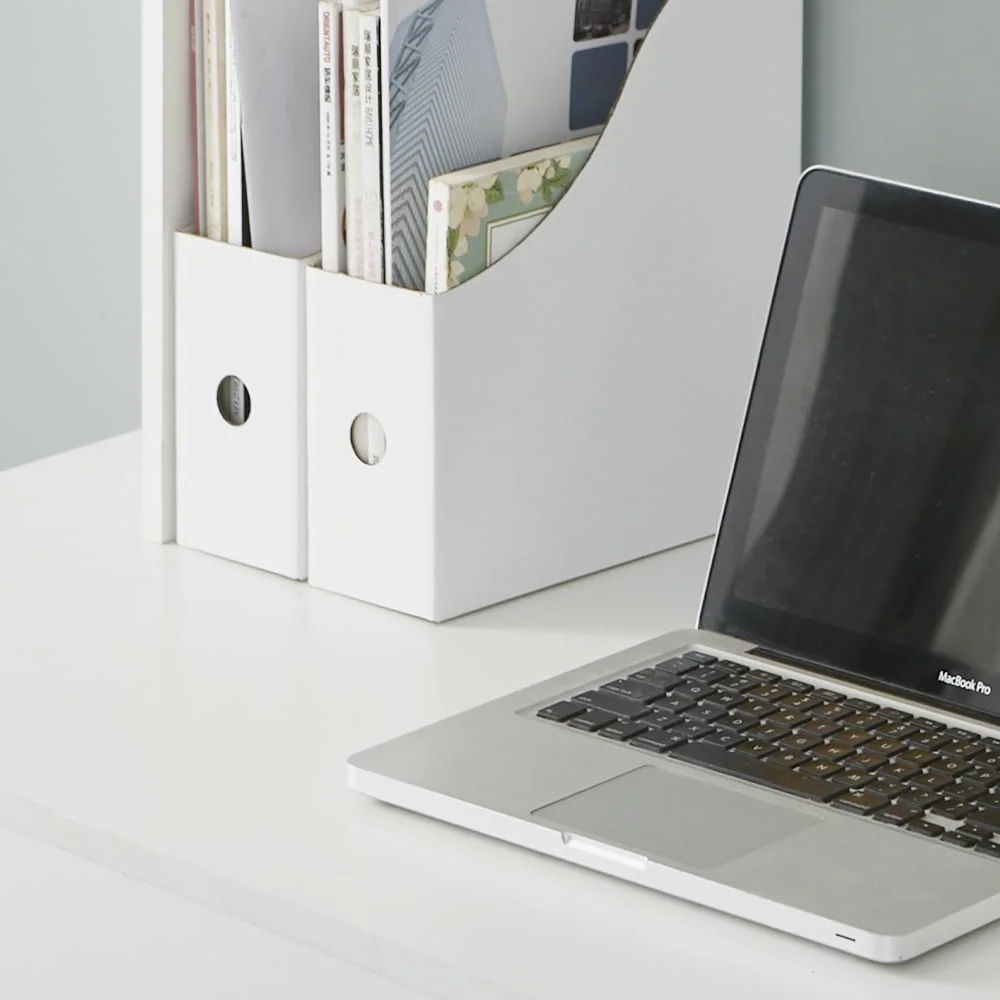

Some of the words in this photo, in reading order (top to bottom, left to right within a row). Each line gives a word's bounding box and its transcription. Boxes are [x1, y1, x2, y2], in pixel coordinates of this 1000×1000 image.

[322, 10, 332, 64] ORIENTAUTO
[351, 44, 361, 97] 瑞丽家居
[938, 670, 976, 691] MacBook
[976, 681, 991, 695] Pro
